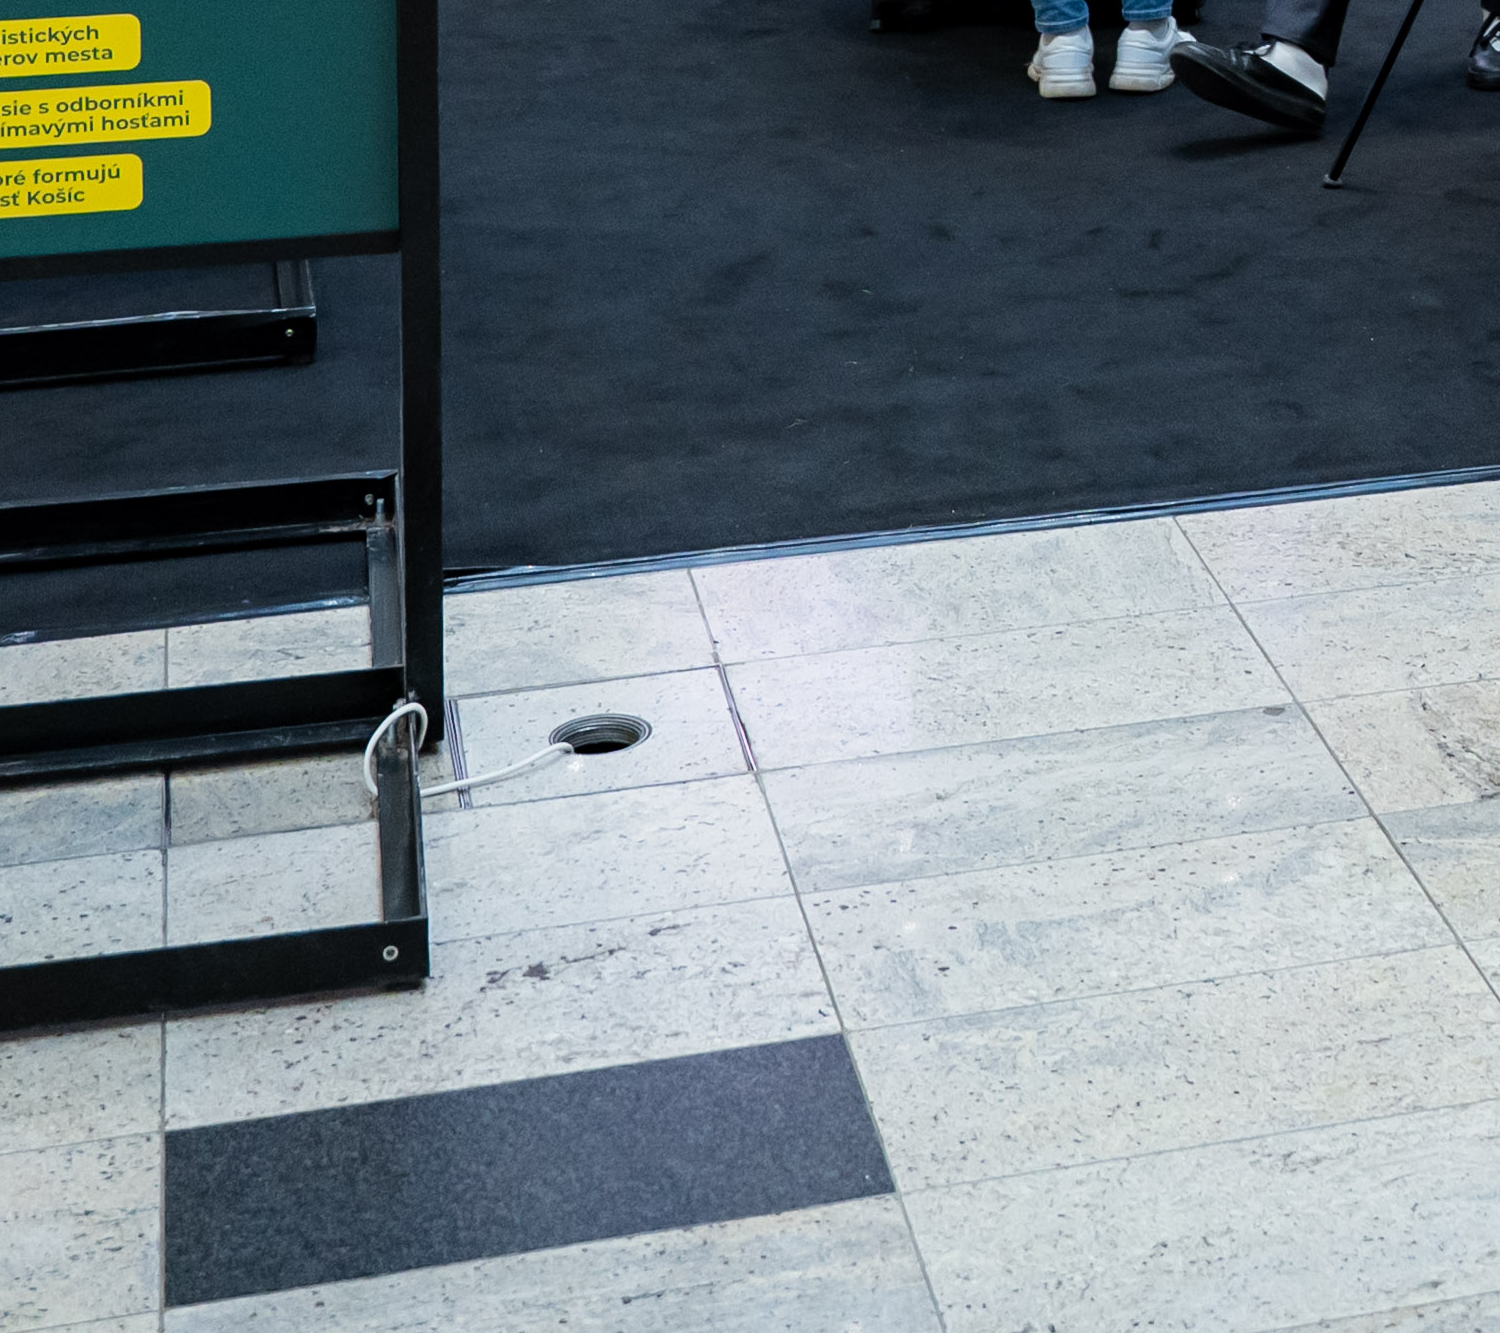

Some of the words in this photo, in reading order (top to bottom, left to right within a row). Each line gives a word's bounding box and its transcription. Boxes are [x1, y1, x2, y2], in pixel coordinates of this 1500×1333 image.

[45, 46, 114, 63] mesta
[38, 104, 50, 116] s
[55, 89, 185, 115] odborníkmi
[101, 109, 191, 131] hosťami
[32, 163, 121, 188] formujú
[26, 185, 86, 207] Košíc
